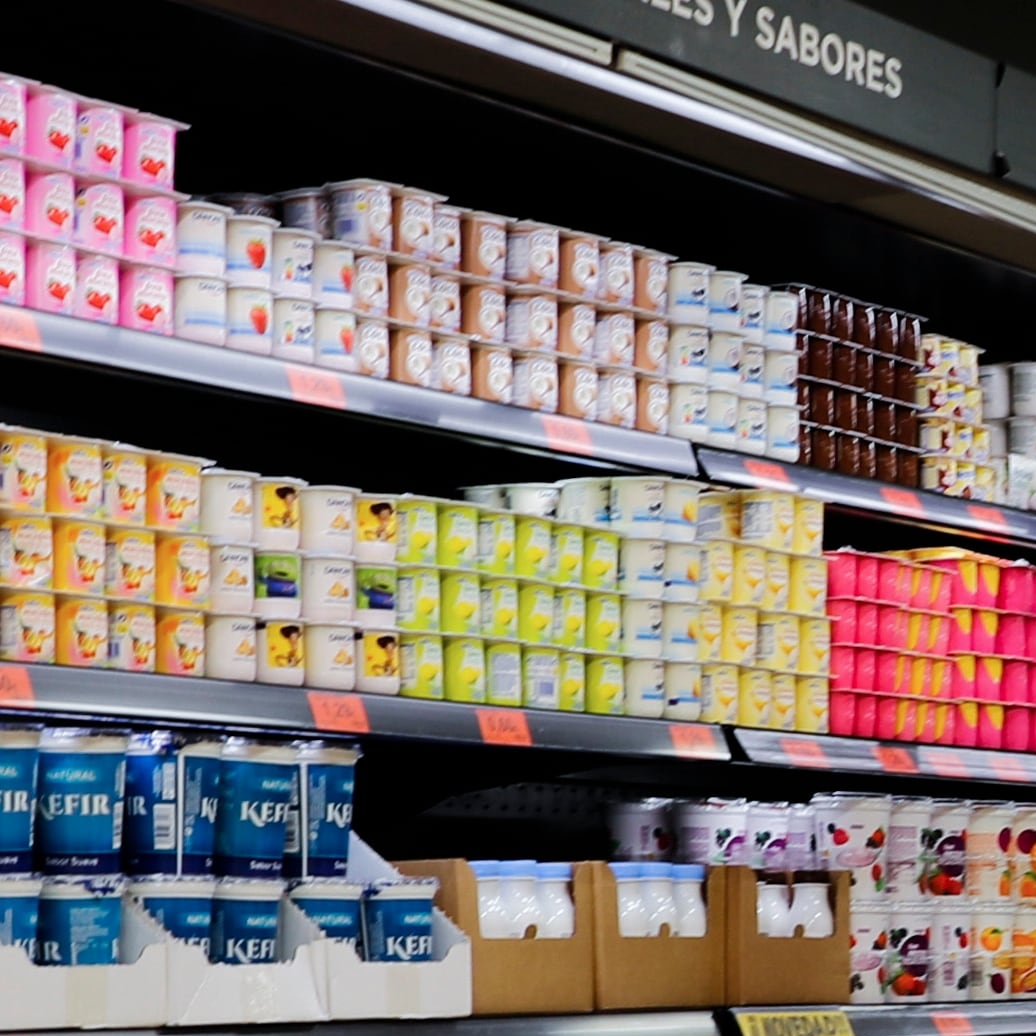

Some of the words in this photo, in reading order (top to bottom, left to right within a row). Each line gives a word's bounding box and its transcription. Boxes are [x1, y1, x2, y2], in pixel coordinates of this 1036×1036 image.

[726, 0, 751, 37] Y
[755, 6, 904, 98] SABORES
[40, 793, 111, 820] KEFIR
[240, 801, 290, 827] KEFI
[226, 938, 275, 963] KEFI
[386, 935, 433, 960] KEFI
